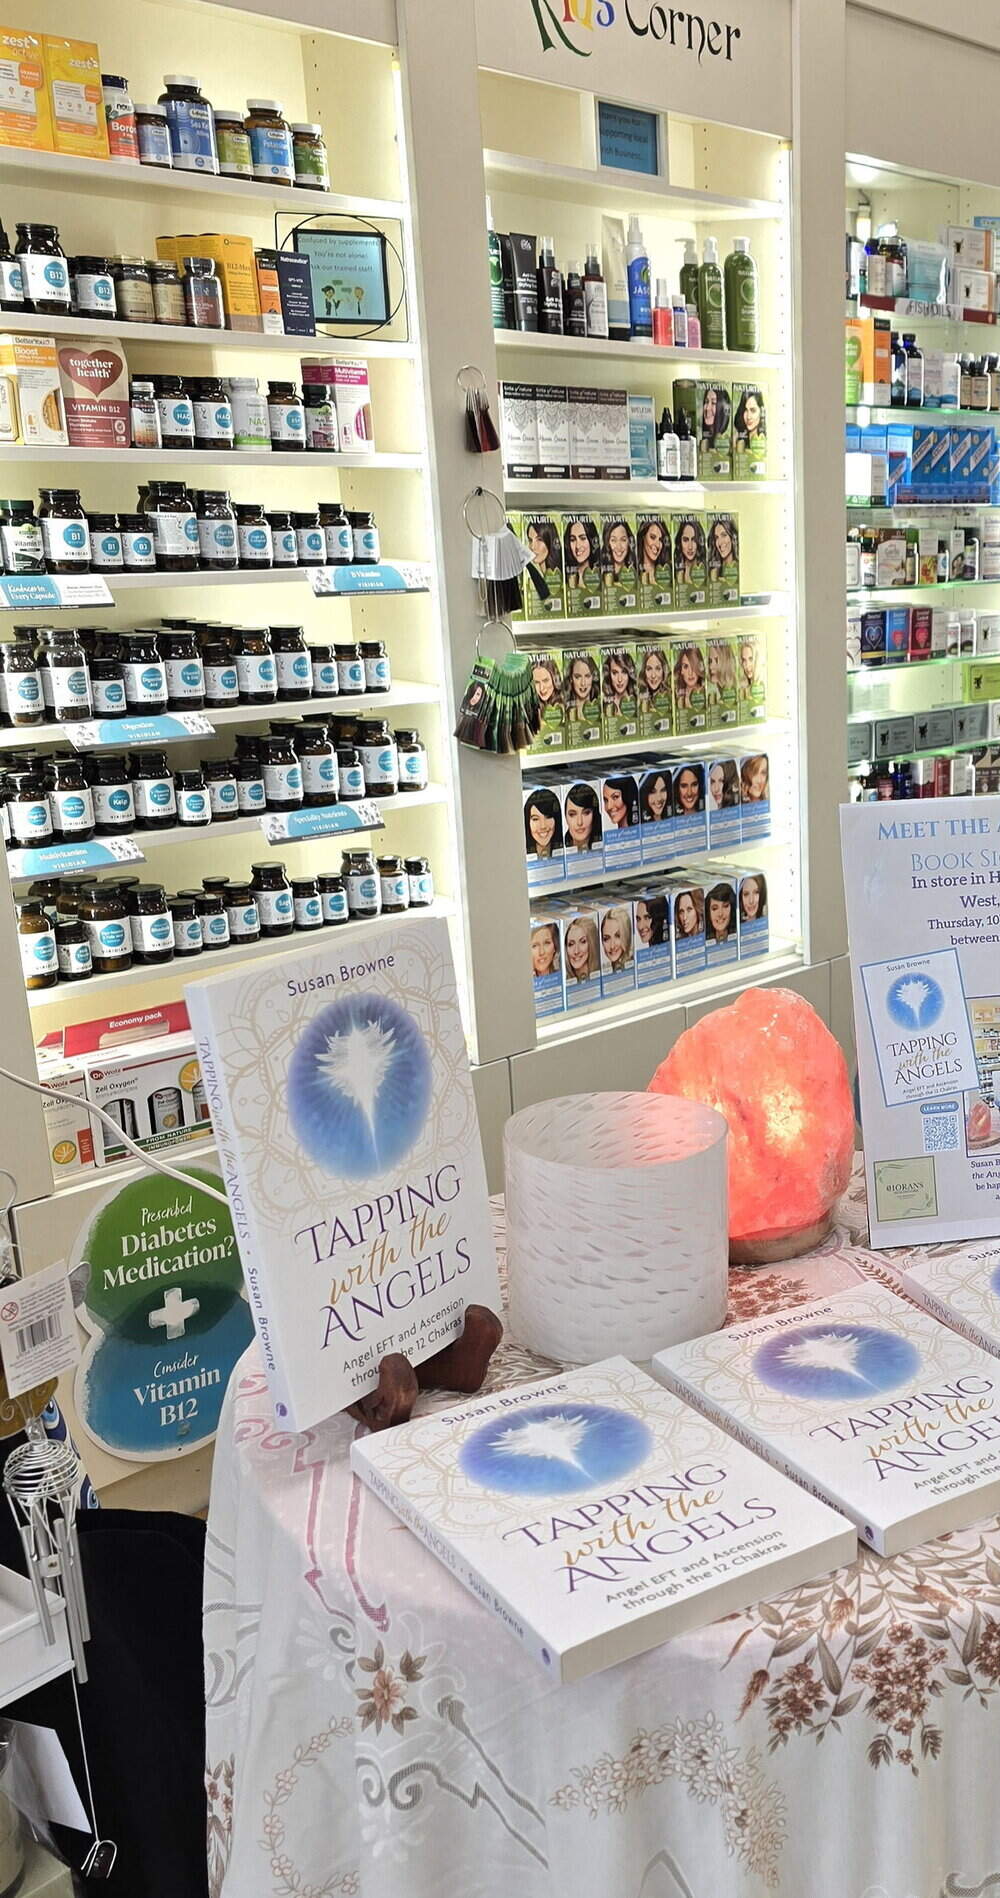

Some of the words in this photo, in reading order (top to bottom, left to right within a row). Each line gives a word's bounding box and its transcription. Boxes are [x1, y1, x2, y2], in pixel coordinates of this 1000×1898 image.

[2, 35, 31, 48] zest
[625, 0, 741, 66] Corner
[49, 271, 63, 280] B12
[98, 286, 112, 295] B12
[70, 358, 114, 370] together
[76, 368, 111, 378] health
[72, 403, 107, 413] VITAMIN
[108, 405, 120, 413] B12
[878, 821, 940, 840] MEET
[945, 818, 990, 836] THE
[911, 853, 974, 871] BOOK
[912, 876, 927, 889] In
[931, 875, 967, 888] store
[971, 872, 985, 885] in
[960, 895, 1000, 908] West,
[928, 917, 984, 930] Thursday,
[951, 935, 999, 946] between
[287, 973, 336, 997] Susan
[341, 953, 395, 983] Browne
[887, 964, 905, 972] Susan
[907, 959, 930, 969] Browne
[109, 1016, 143, 1029] Economy
[145, 1011, 162, 1022] pack
[887, 1032, 958, 1057] TAPPING
[894, 1058, 963, 1086] ANGELS
[898, 1051, 929, 1071] with
[932, 1047, 952, 1062] the
[95, 1085, 108, 1093] Zell
[146, 1134, 165, 1144] FROM
[166, 1127, 192, 1139] NATURE
[971, 1160, 993, 1168] Susan
[972, 1172, 984, 1180] the
[141, 1196, 192, 1226] Prescribed
[200, 1039, 222, 1112] TAPPING
[226, 1174, 251, 1240] ANGELS
[248, 1267, 262, 1309] Susan
[257, 1317, 276, 1371] Browne
[294, 1164, 461, 1264] TAPPING
[120, 1218, 217, 1257] Diabetes
[103, 1235, 235, 1290] Medication?
[329, 1231, 402, 1305] with
[409, 1207, 452, 1259] the
[320, 1237, 471, 1350] ANGELS
[343, 1346, 374, 1373] Angel
[376, 1335, 395, 1357] EFT
[398, 1322, 416, 1342] and
[419, 1297, 464, 1330] Ascension
[416, 1336, 426, 1352] 12
[428, 1317, 462, 1343] Chakras
[728, 1322, 773, 1343] Susan
[776, 1304, 833, 1330] Browne
[153, 1354, 200, 1378] Consider
[133, 1368, 221, 1406] Vitamin
[160, 1398, 199, 1426] B12
[441, 1403, 497, 1427] Susan
[500, 1382, 569, 1409] Browne
[808, 1375, 994, 1443] TAPPING
[866, 1416, 941, 1459] with
[943, 1397, 995, 1425] the
[913, 1470, 948, 1491] Angel
[949, 1463, 970, 1478] EFT
[975, 1453, 997, 1467] and
[930, 1475, 980, 1496] through
[502, 1463, 728, 1548] TAPPING
[563, 1512, 657, 1566] with
[663, 1486, 725, 1524] the
[554, 1497, 777, 1594] ANGELS
[605, 1582, 649, 1604] Angel
[651, 1569, 679, 1586] EFT
[682, 1557, 709, 1574] and
[712, 1530, 784, 1561] Ascension
[622, 1580, 685, 1610] through
[686, 1571, 713, 1586] the
[714, 1563, 729, 1576] 12
[730, 1541, 788, 1567] Chakras
